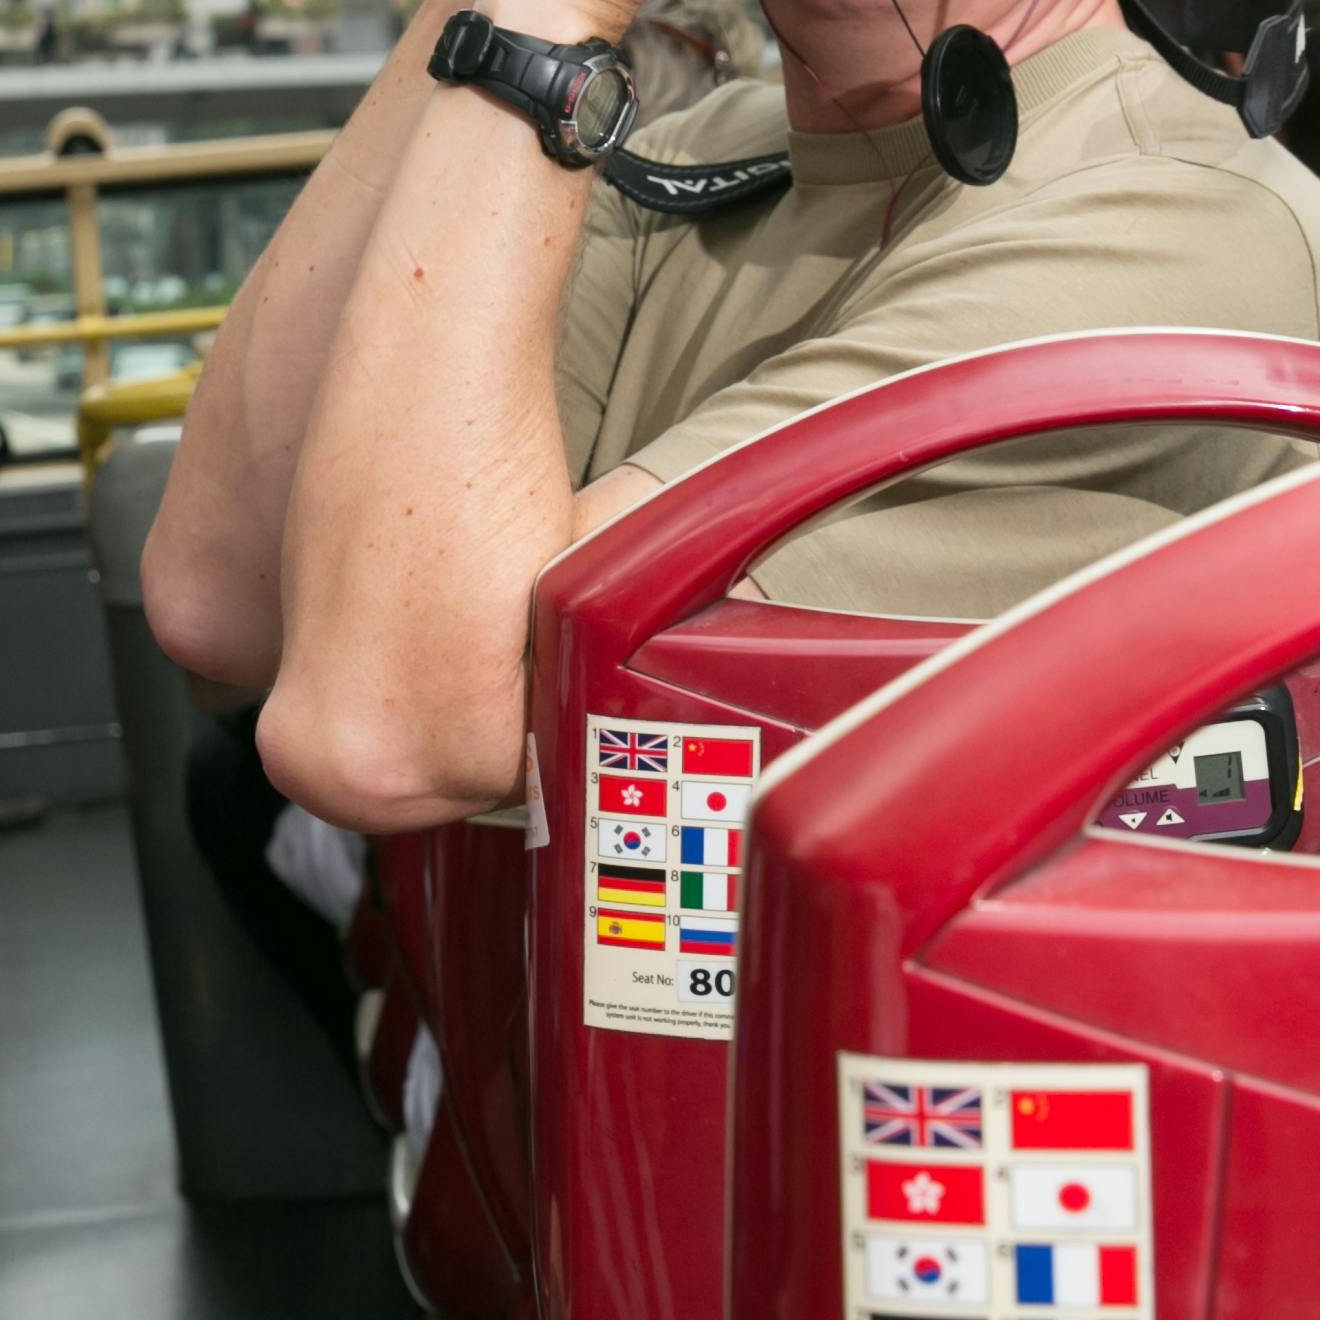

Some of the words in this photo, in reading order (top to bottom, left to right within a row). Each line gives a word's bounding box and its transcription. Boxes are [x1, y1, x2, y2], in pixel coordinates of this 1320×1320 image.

[593, 728, 597, 739] 1
[673, 736, 681, 747] 2
[591, 772, 598, 784] 3
[672, 781, 680, 791] 4
[590, 817, 598, 829] 5
[672, 825, 680, 836] 6
[590, 862, 597, 873] 7
[671, 870, 679, 881] 8
[589, 906, 597, 917] 9
[668, 915, 680, 926] 10
[632, 971, 654, 985] Seat
[656, 974, 674, 986] No:
[689, 968, 737, 997] 80
